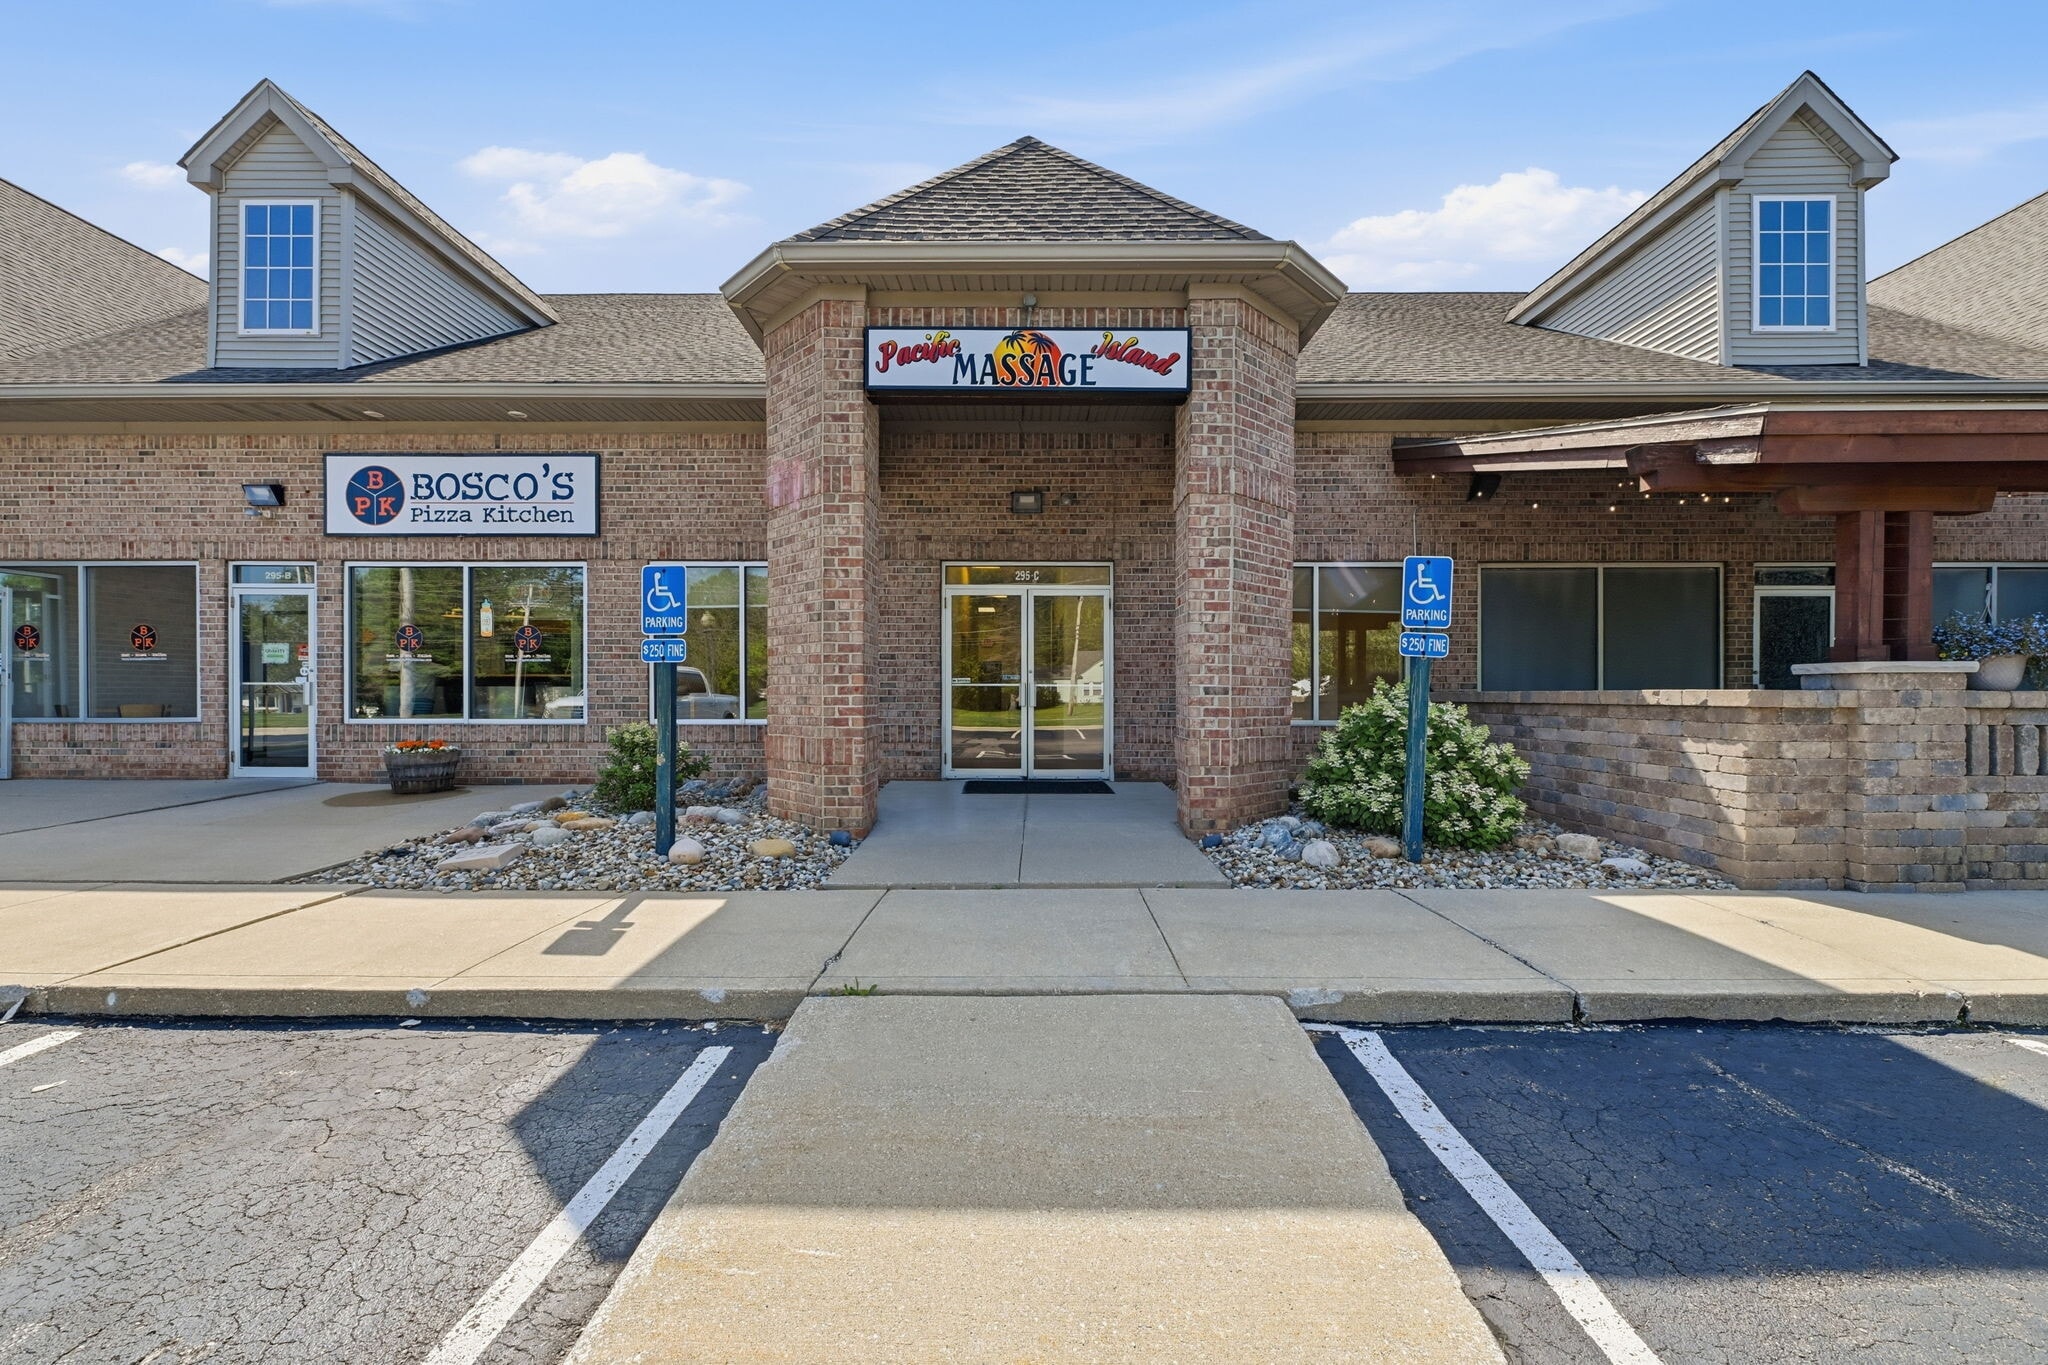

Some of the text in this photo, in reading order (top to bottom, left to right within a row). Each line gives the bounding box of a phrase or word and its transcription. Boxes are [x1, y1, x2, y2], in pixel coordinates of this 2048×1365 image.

[876, 330, 1181, 376] Pacific Island
[952, 353, 1097, 386] MASSAGE
[367, 471, 384, 490] B
[410, 463, 575, 501] BOSCO'S
[410, 505, 575, 523] Pizza Kitchen
[265, 572, 292, 580] 295-B
[1015, 570, 1040, 581] 295-C
[645, 616, 683, 628] PARKING
[1406, 609, 1447, 621] PARKING
[644, 644, 684, 657] $250 FINE
[1402, 638, 1446, 652] $250 FINE
